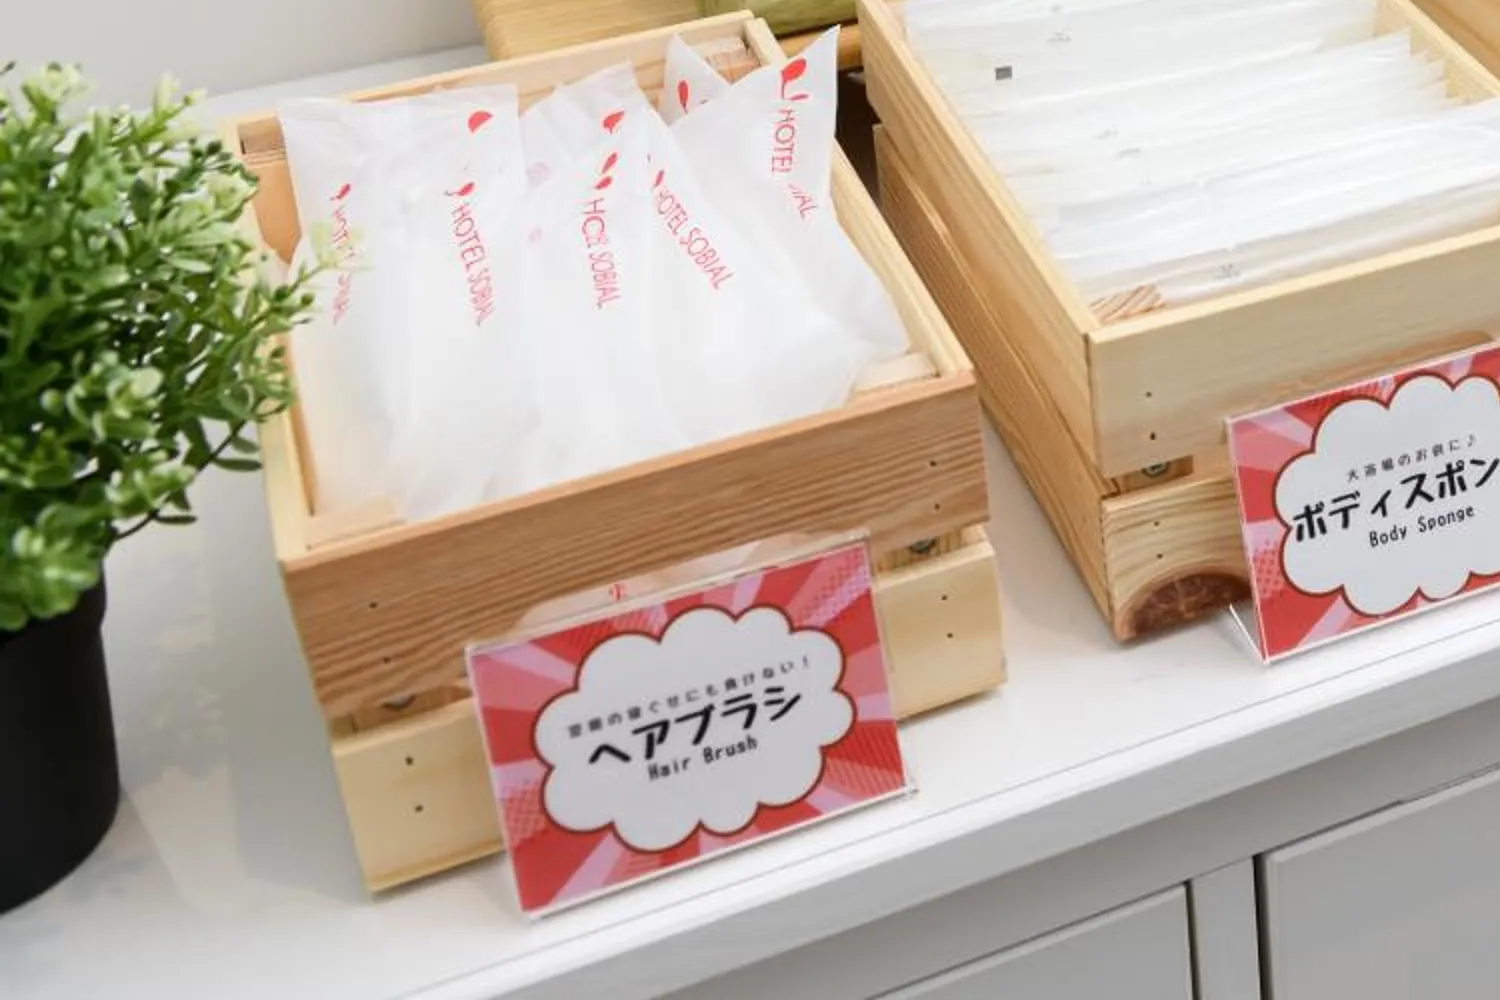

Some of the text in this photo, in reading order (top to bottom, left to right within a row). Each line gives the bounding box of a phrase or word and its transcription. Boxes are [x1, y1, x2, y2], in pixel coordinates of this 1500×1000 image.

[451, 202, 486, 272] HOTEL
[679, 226, 734, 290] SOBIAL
[589, 250, 622, 309] SOBIAL
[1368, 506, 1475, 548] Body Sponge
[588, 685, 802, 765] ヘアブラシ
[648, 734, 759, 781] Hair Brush
